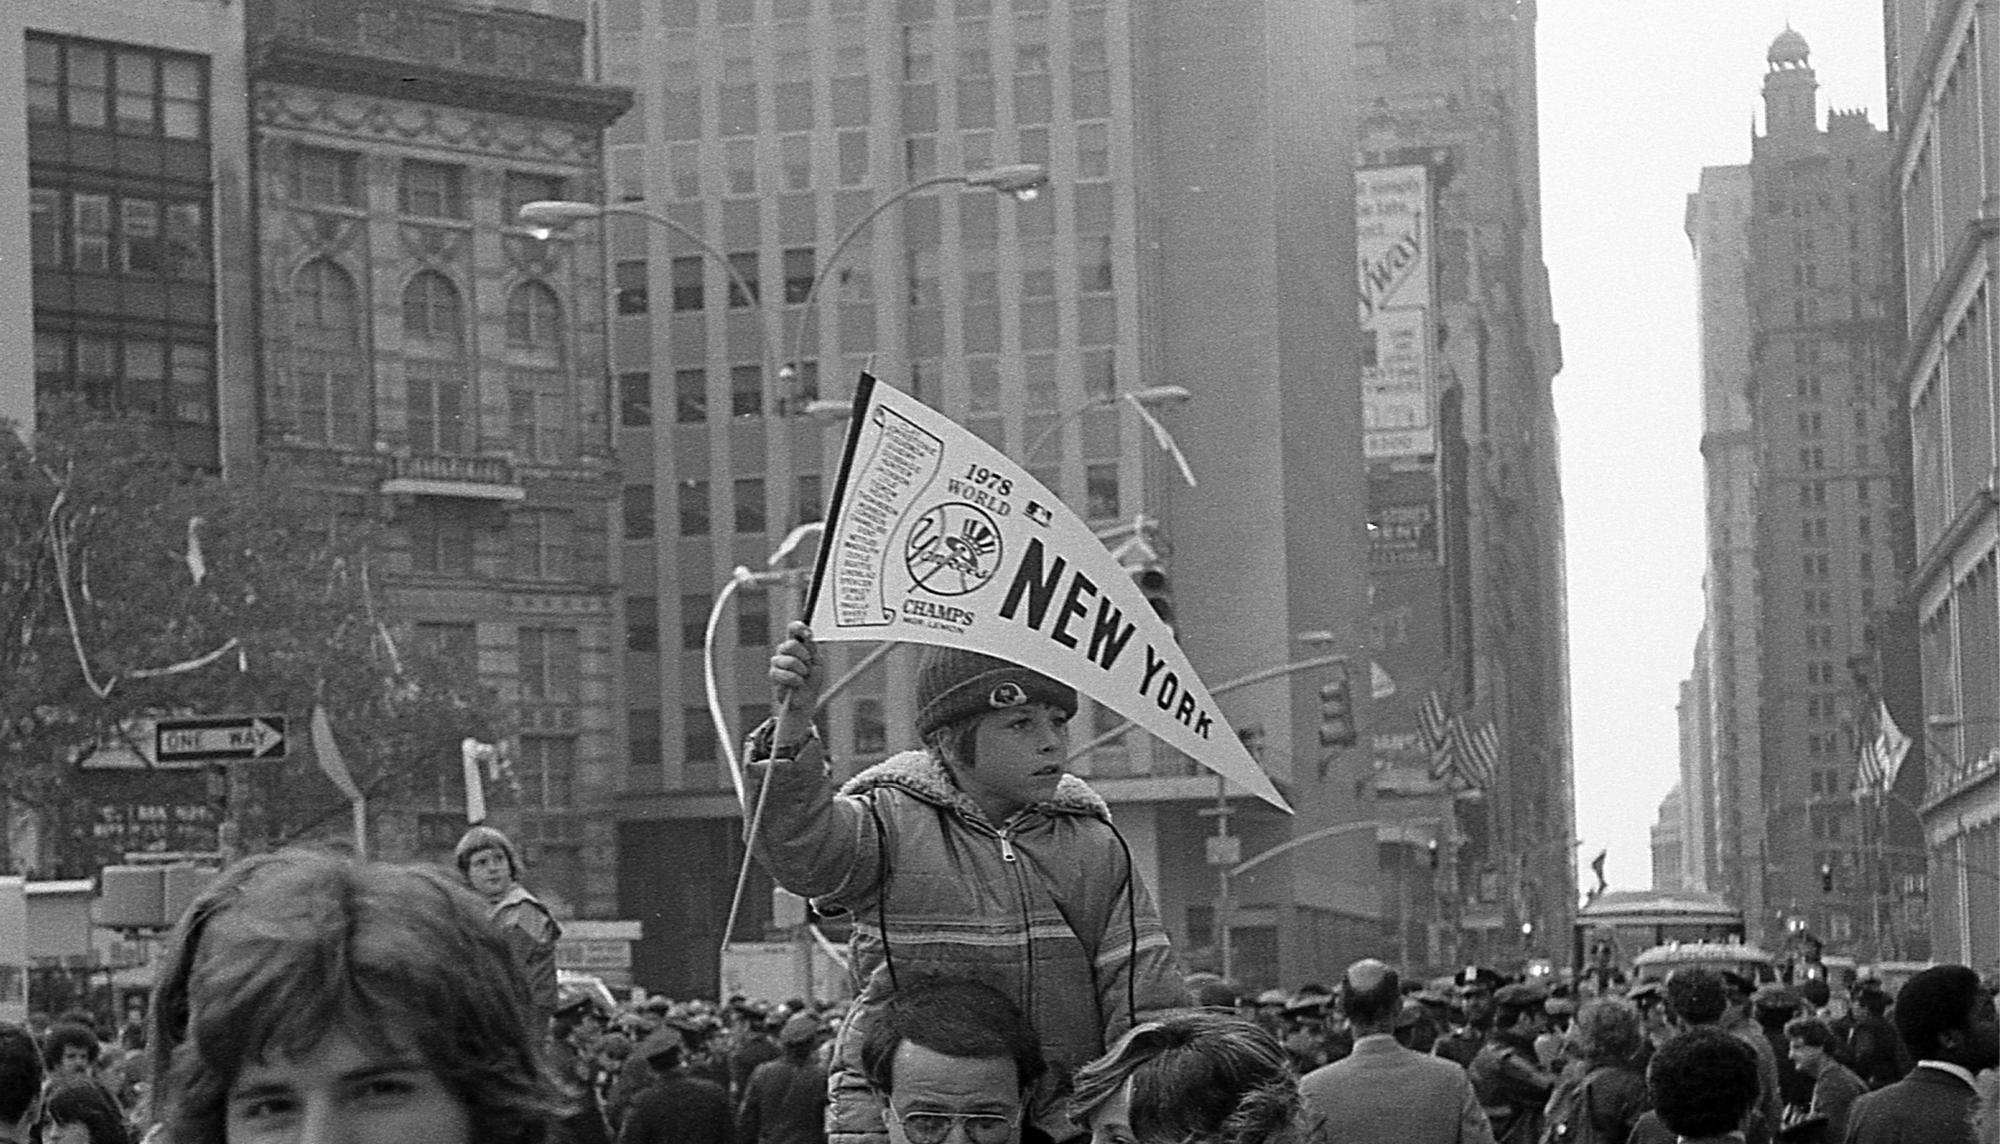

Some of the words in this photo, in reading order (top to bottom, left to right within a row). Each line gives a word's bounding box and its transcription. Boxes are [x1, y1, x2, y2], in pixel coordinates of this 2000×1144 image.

[965, 464, 1013, 496] 1978
[948, 479, 1011, 516] WORLD
[906, 517, 990, 579] Yankees
[903, 599, 975, 626] CHAMPS
[998, 536, 1137, 671] NEW
[1138, 643, 1213, 740] YORK
[167, 731, 201, 748] ONE
[229, 730, 265, 746] WAY
